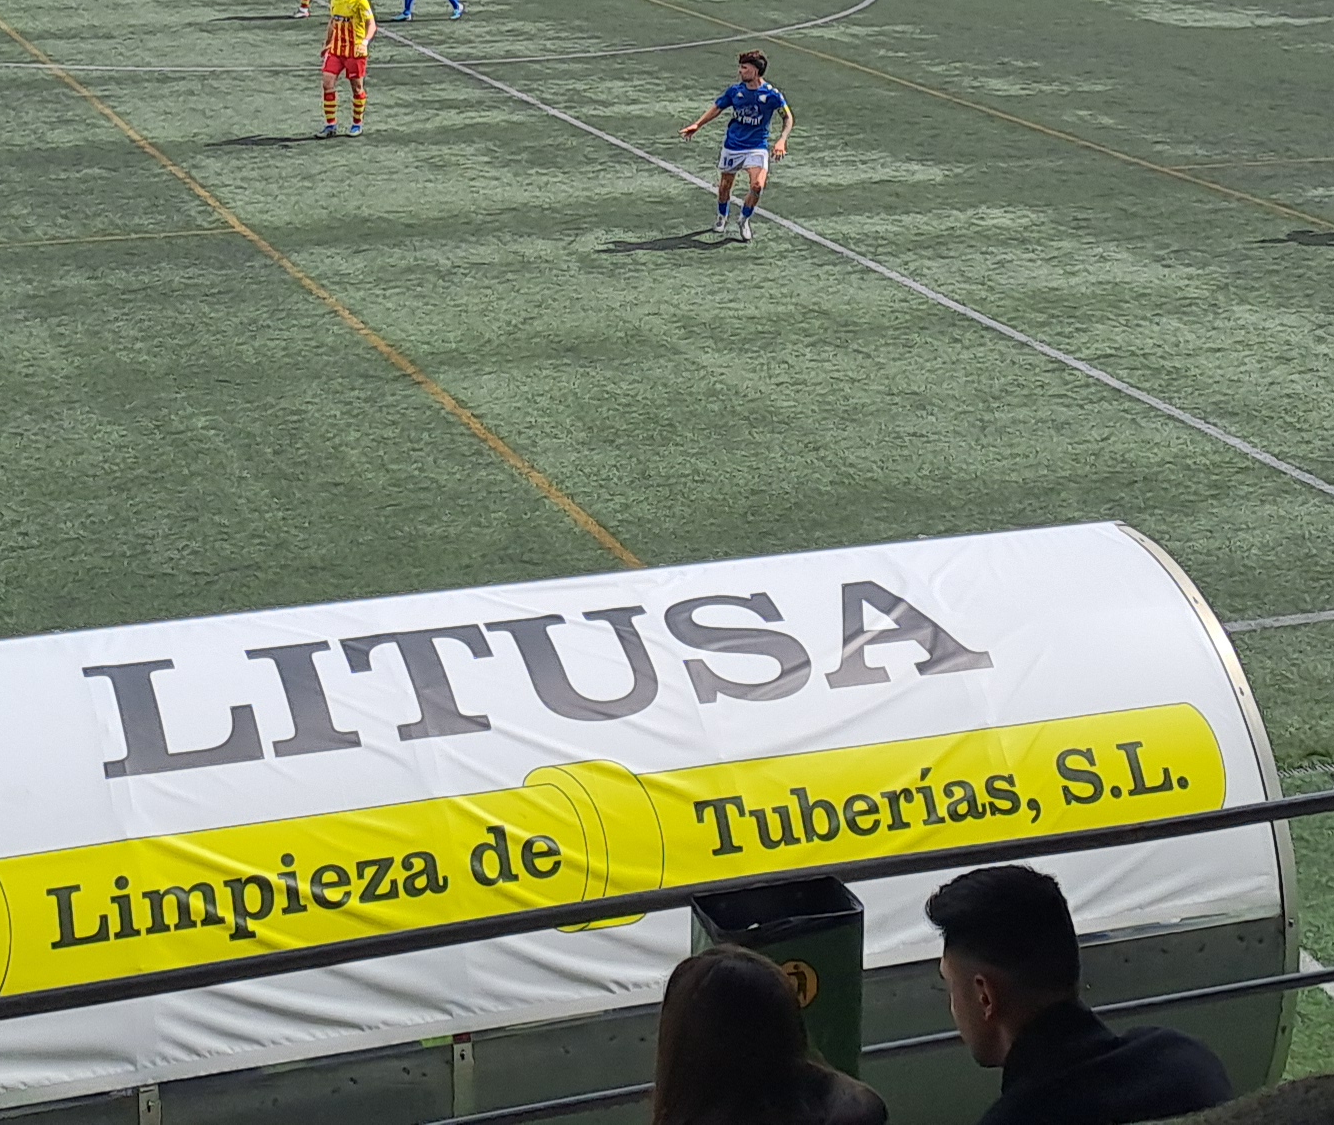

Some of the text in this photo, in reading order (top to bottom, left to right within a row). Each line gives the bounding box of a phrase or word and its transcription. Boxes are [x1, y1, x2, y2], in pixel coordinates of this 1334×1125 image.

[81, 581, 992, 780] LITUSA
[46, 739, 1192, 949] Limpieza de Tuberías, S.L.
